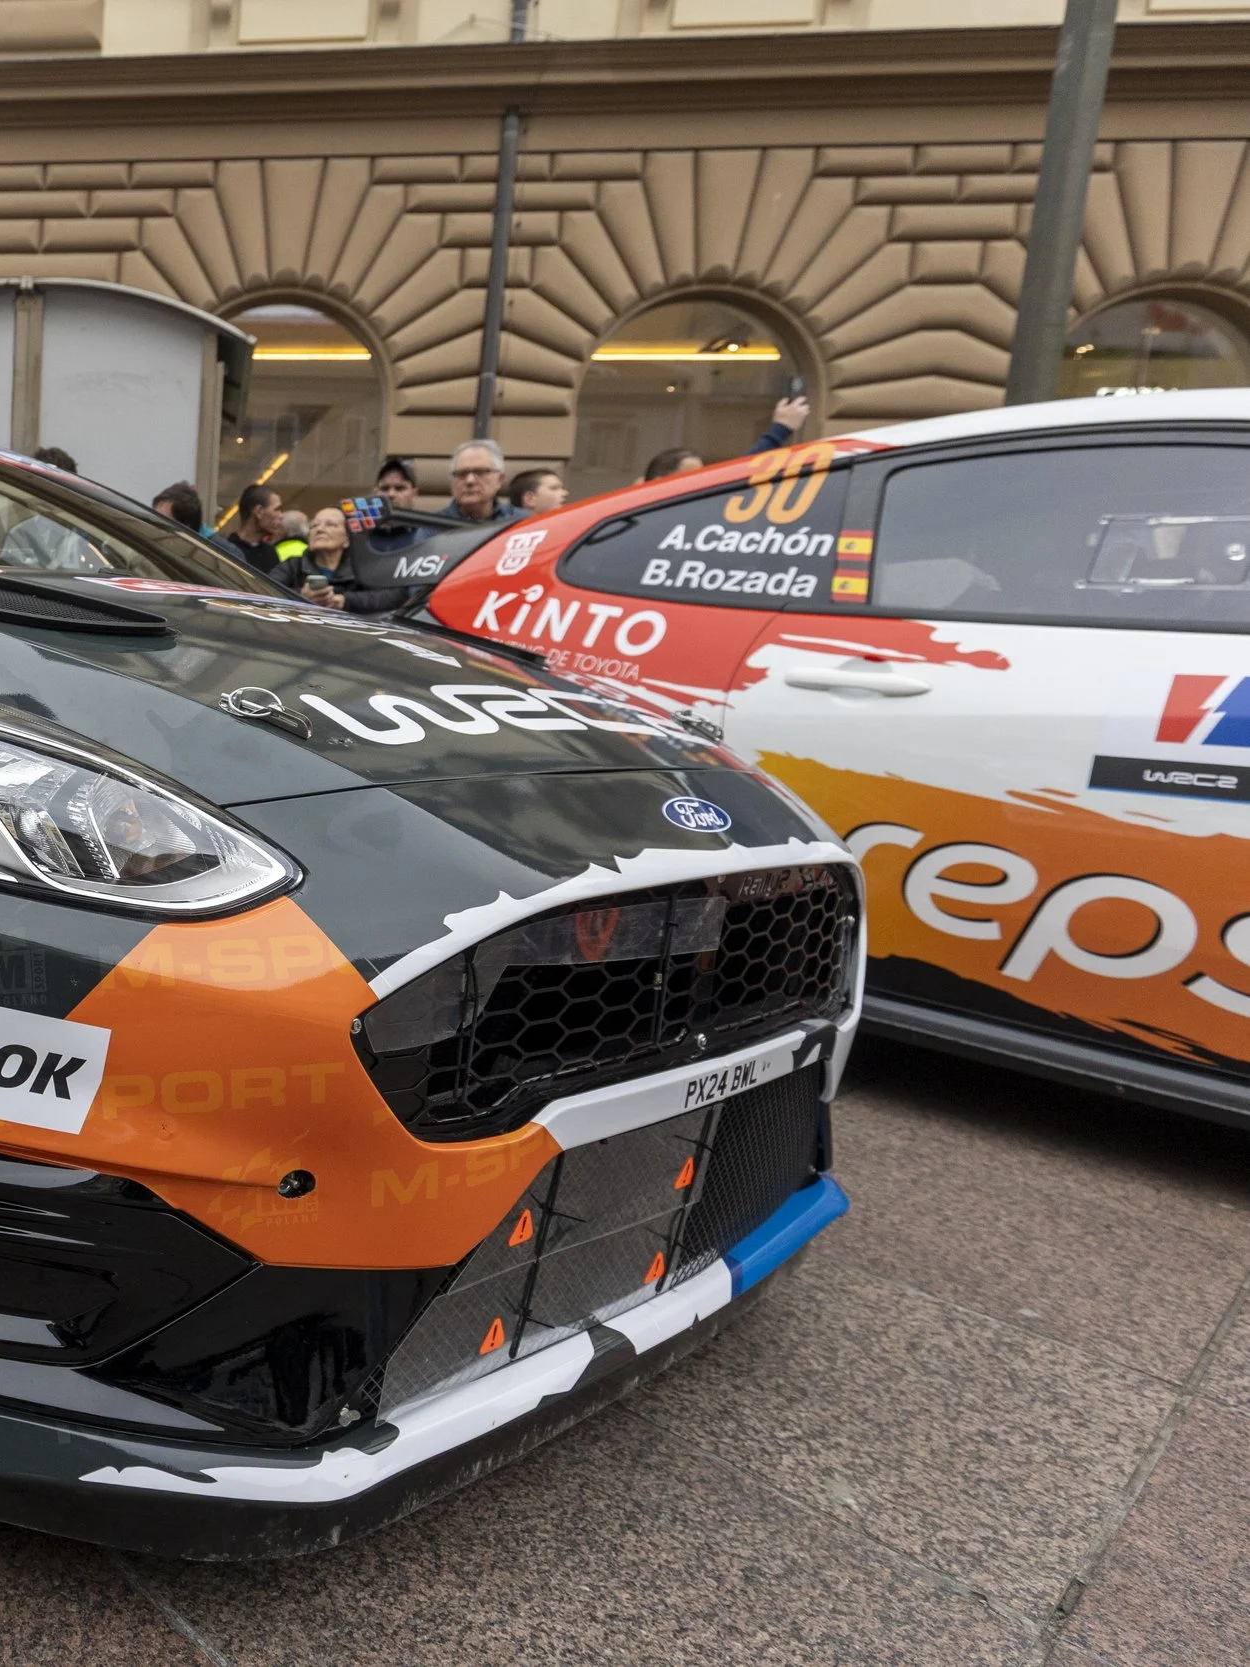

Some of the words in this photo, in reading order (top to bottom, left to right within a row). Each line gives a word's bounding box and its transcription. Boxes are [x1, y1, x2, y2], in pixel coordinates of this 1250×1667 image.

[723, 441, 837, 525] 30
[658, 523, 835, 557] A.Cachón
[640, 558, 819, 598] B.Rozada
[574, 653, 641, 680] TOYOTA
[1142, 768, 1239, 790] WRC2
[678, 801, 725, 830] Ford
[684, 1069, 729, 1109] PX24
